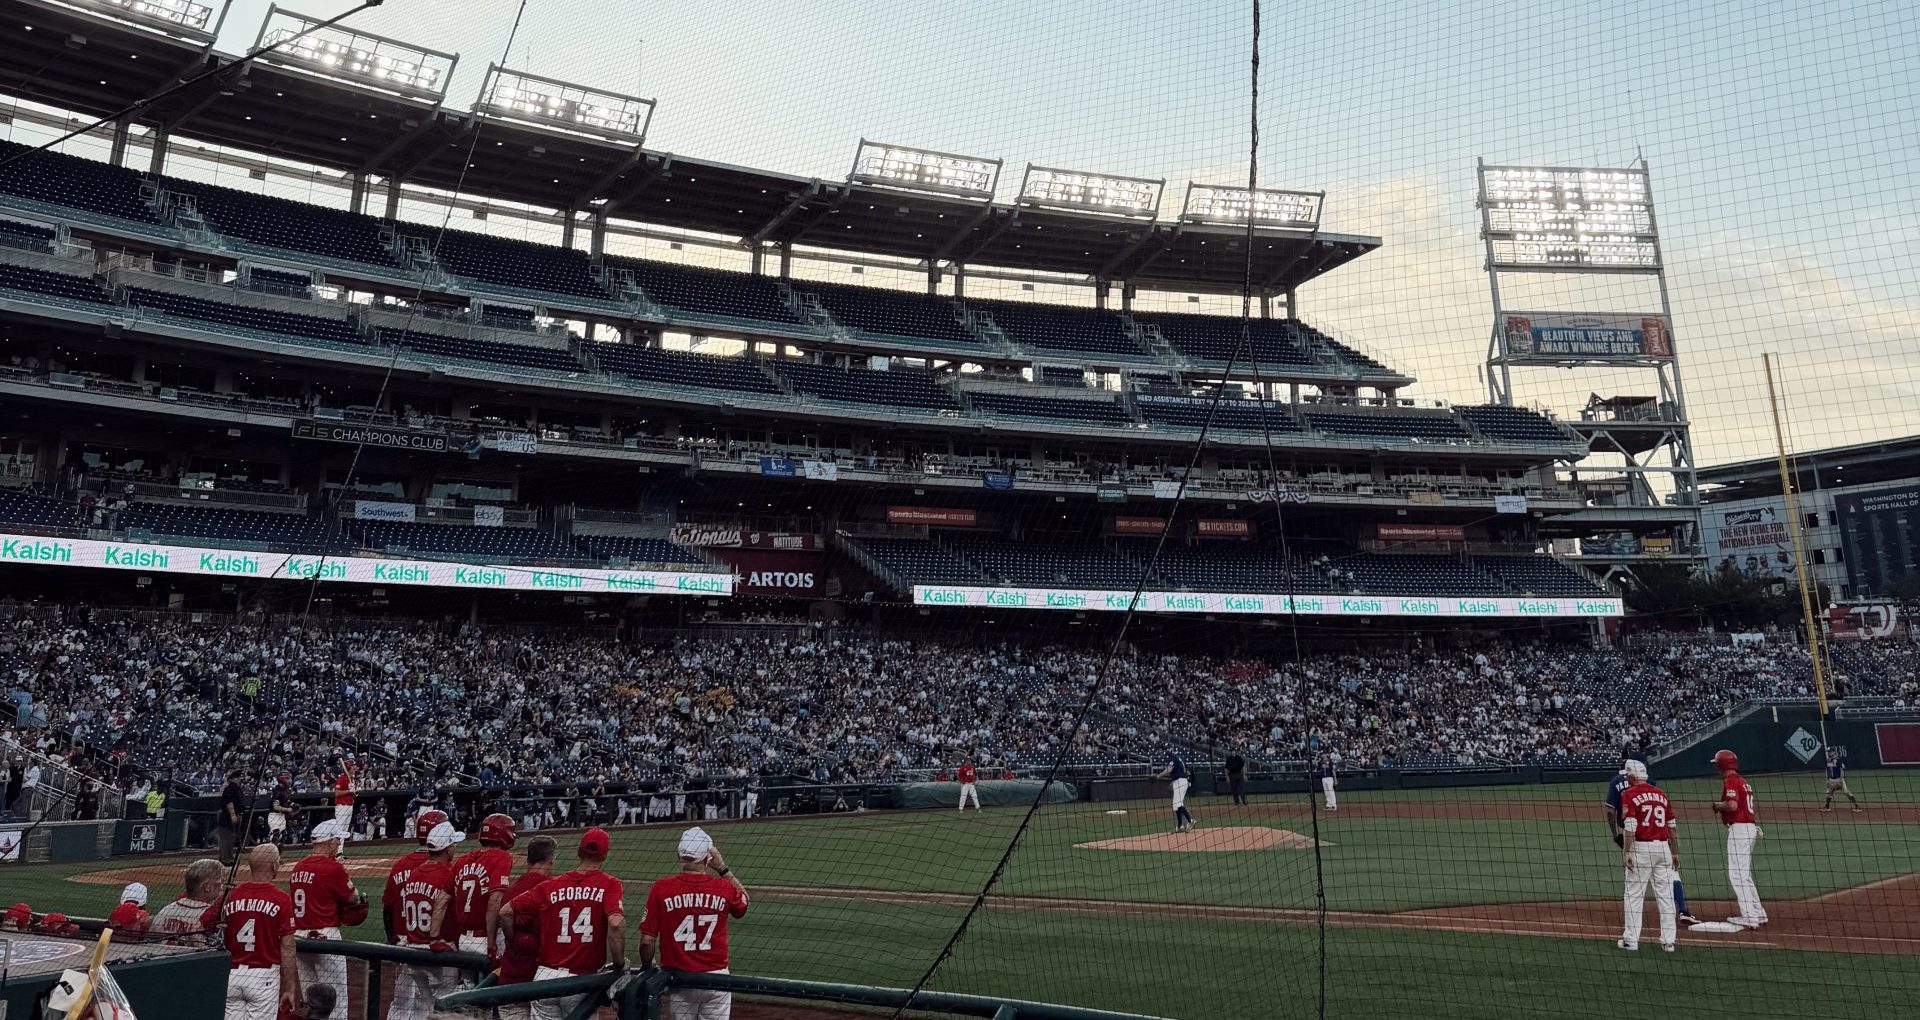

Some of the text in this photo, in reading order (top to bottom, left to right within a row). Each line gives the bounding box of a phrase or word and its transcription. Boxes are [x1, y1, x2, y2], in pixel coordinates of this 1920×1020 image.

[1542, 329, 1634, 342] BEAUTIFUL VIEWS AND
[1539, 342, 1641, 354] AWARD WINNING BREWS
[297, 426, 444, 450] FIS CHAMPIONS CLUB
[1862, 491, 1919, 504] WASHINGTON DC
[1863, 503, 1890, 512] SPORTS
[1891, 501, 1908, 509] HALL
[1720, 522, 1785, 538] THE NEW HOME FOR
[774, 536, 804, 548] NATITUDE
[1719, 532, 1790, 549] NATIONALS BASEBALL
[1, 540, 724, 593] Kalshi Kalshi Kalshi Kalshi Kalshi Kalshi Kalshi Kalshi Kalshi
[748, 571, 815, 589] ARTOIS
[923, 588, 967, 605] Kalshi
[986, 591, 1028, 607] Kalshi
[1046, 593, 1087, 608] Kalshi
[1165, 595, 1205, 609] Kalshi
[1225, 597, 1264, 611] Kalshi
[1342, 599, 1382, 613] Kalshi
[1400, 601, 1440, 614] Kalshi
[1458, 602, 1499, 614] Kalshi
[1518, 602, 1558, 615] Kalshi
[1576, 602, 1616, 614] Kalshi
[1641, 805, 1666, 828] 79
[130, 840, 155, 851] MLB
[290, 871, 315, 884] CLYDE
[393, 869, 411, 886] VAN
[454, 863, 490, 896] CCORMICK
[405, 881, 441, 901] SCOMAN
[462, 879, 476, 913] 7
[550, 886, 604, 905] GEORGIA
[223, 898, 281, 918] TIMMONS
[294, 888, 306, 918] 9
[664, 893, 727, 912] DOWNING
[406, 900, 432, 933] 06
[556, 906, 594, 944] 14
[236, 918, 256, 952] 4
[673, 914, 719, 952] 47
